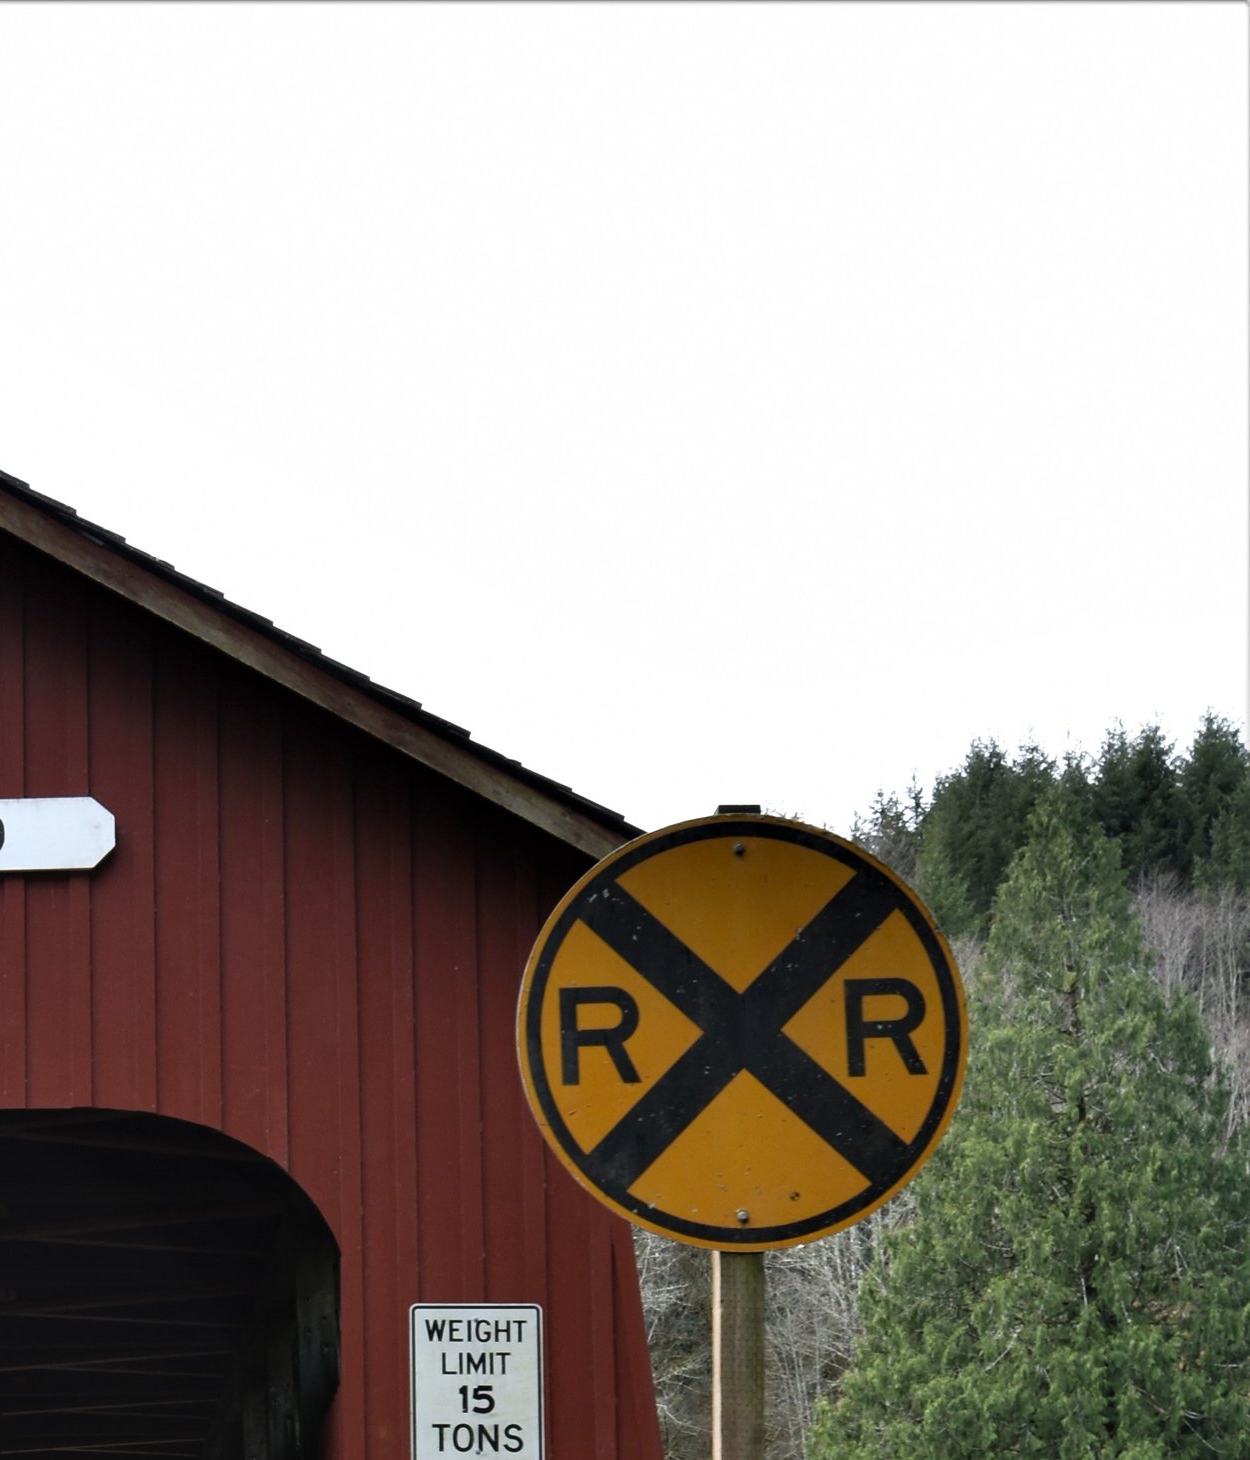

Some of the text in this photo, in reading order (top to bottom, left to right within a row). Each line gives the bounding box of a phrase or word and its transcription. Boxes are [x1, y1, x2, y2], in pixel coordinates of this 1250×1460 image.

[558, 977, 929, 1086] R R
[424, 1319, 528, 1343] WEIGHT
[441, 1352, 511, 1375] LIMIT
[458, 1385, 495, 1414] 15
[431, 1423, 524, 1453] TONS
